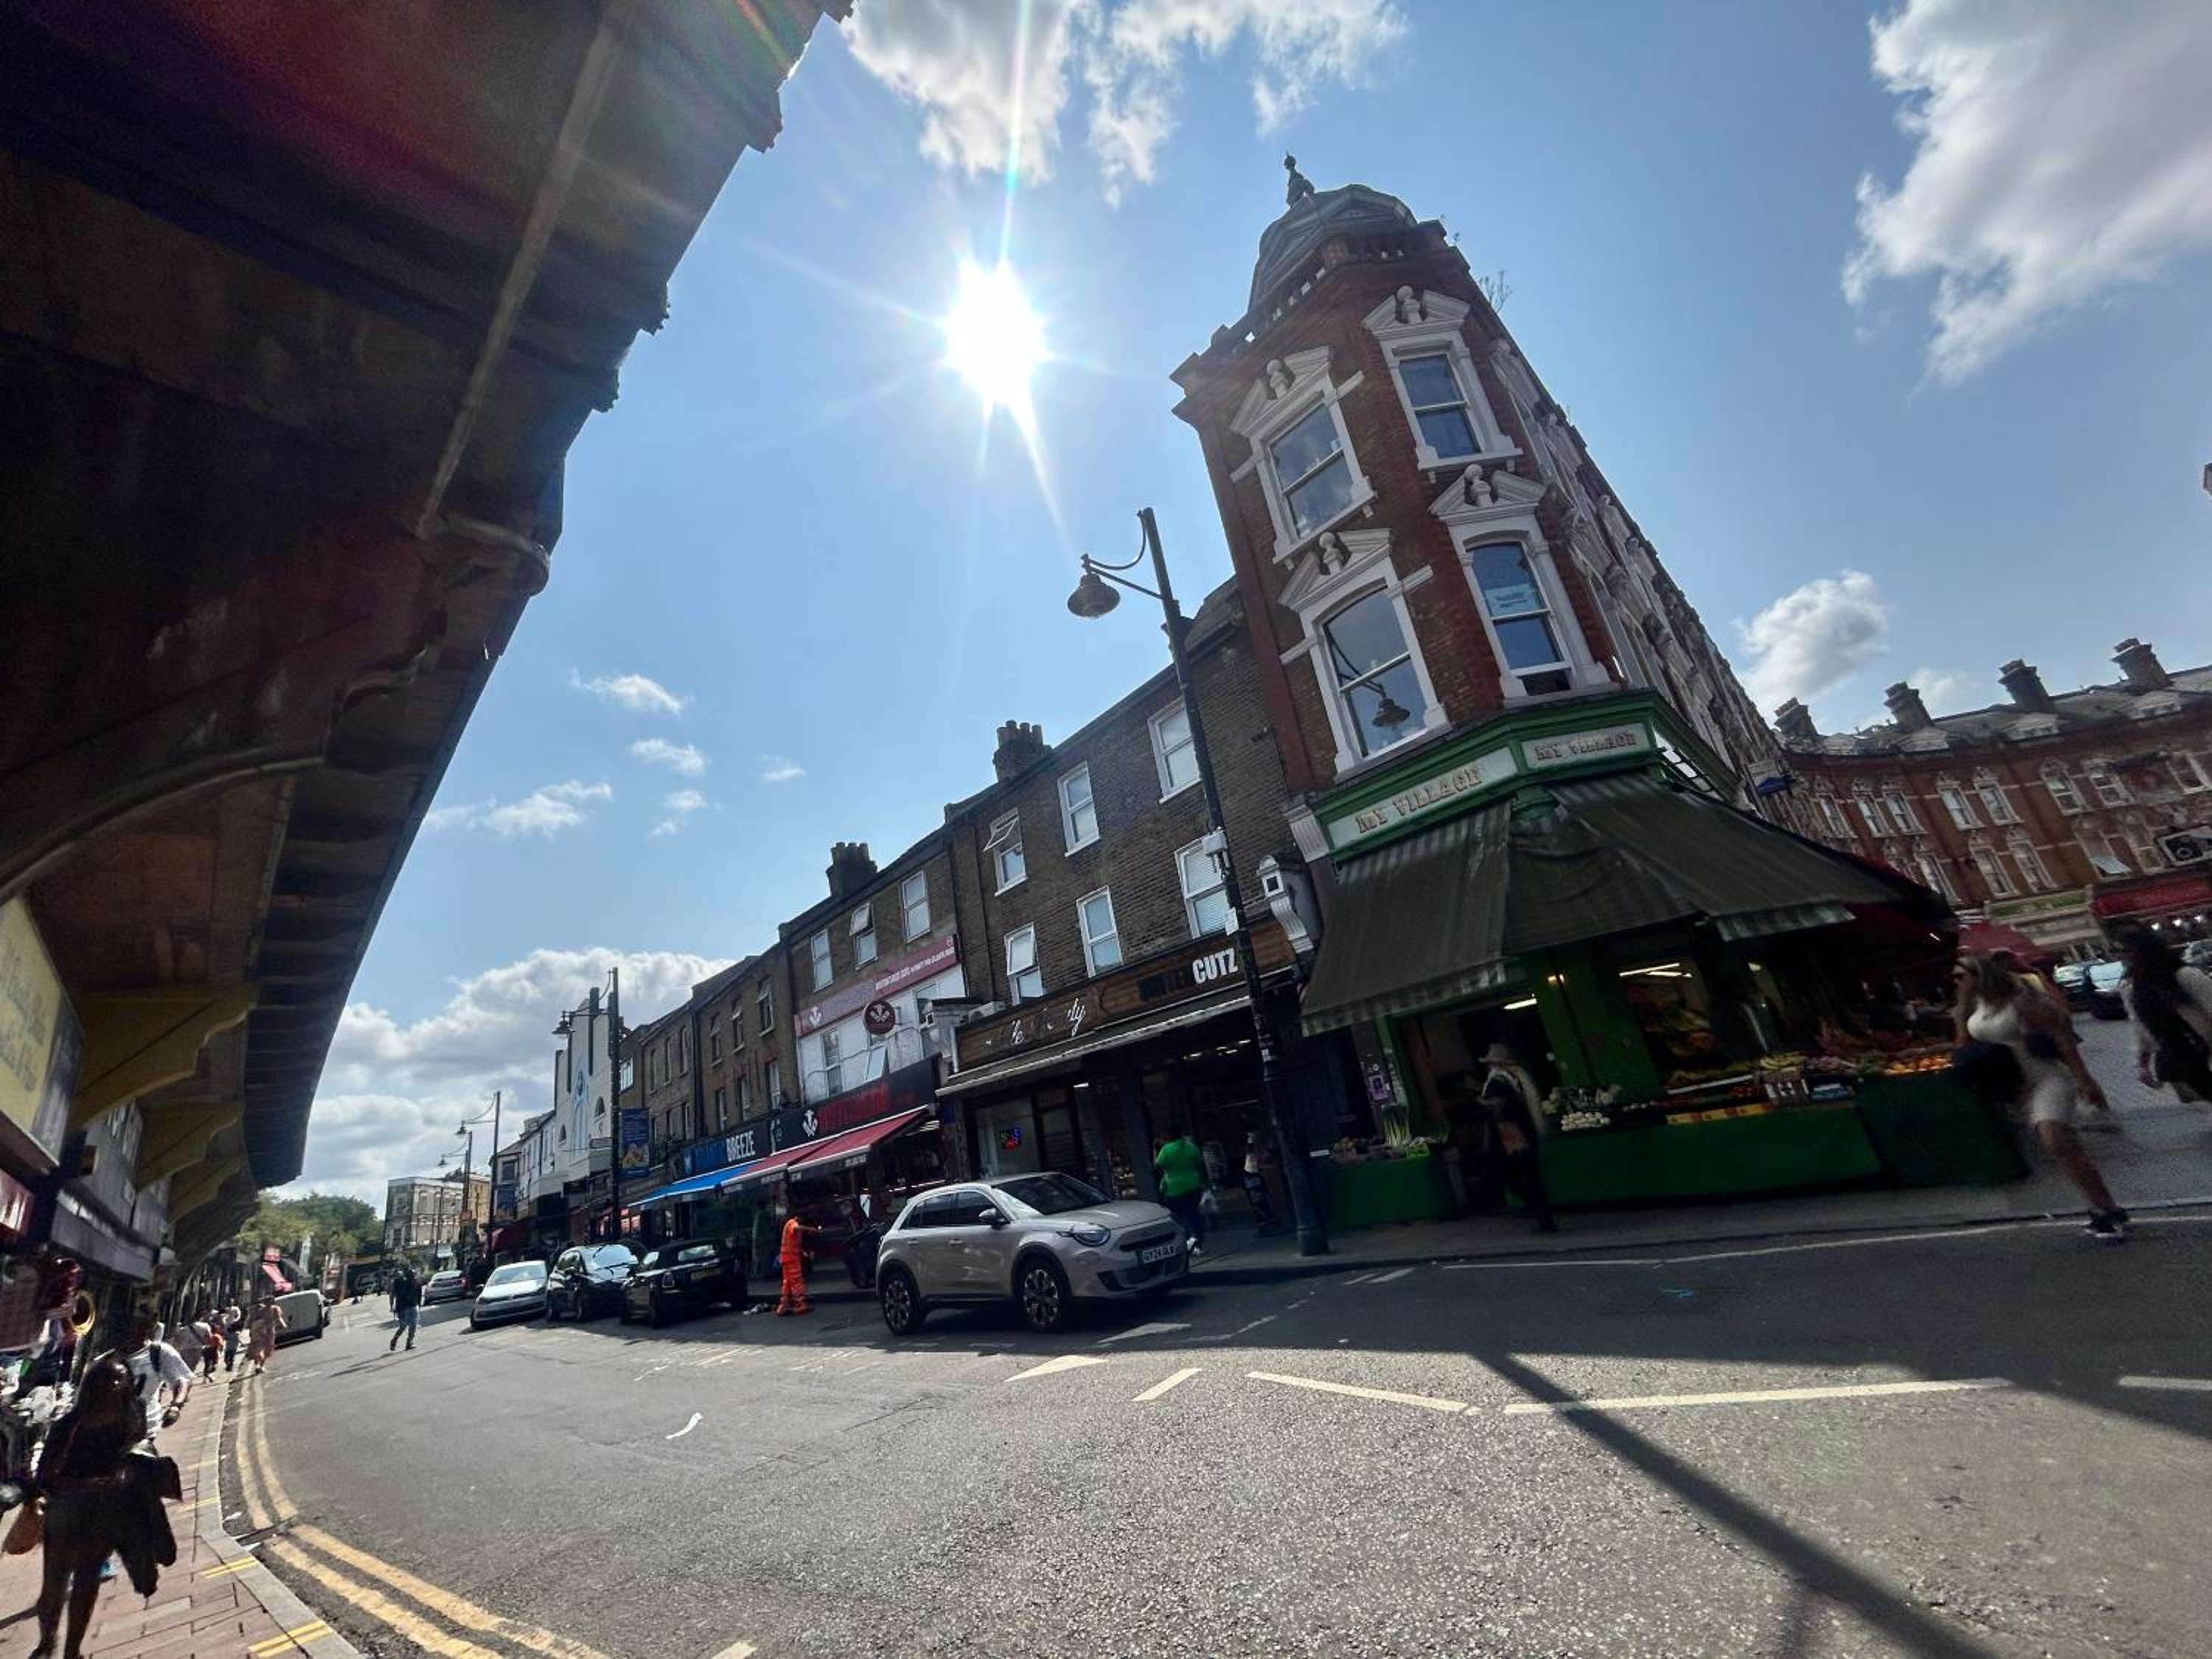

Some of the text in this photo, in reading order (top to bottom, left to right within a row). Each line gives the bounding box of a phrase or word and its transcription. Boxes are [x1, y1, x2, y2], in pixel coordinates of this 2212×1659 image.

[1568, 731, 1638, 754] VILLAGE
[1391, 765, 1483, 816] VILLAGE
[1192, 947, 1238, 984] CUTZ
[726, 1130, 756, 1163] BREEZE
